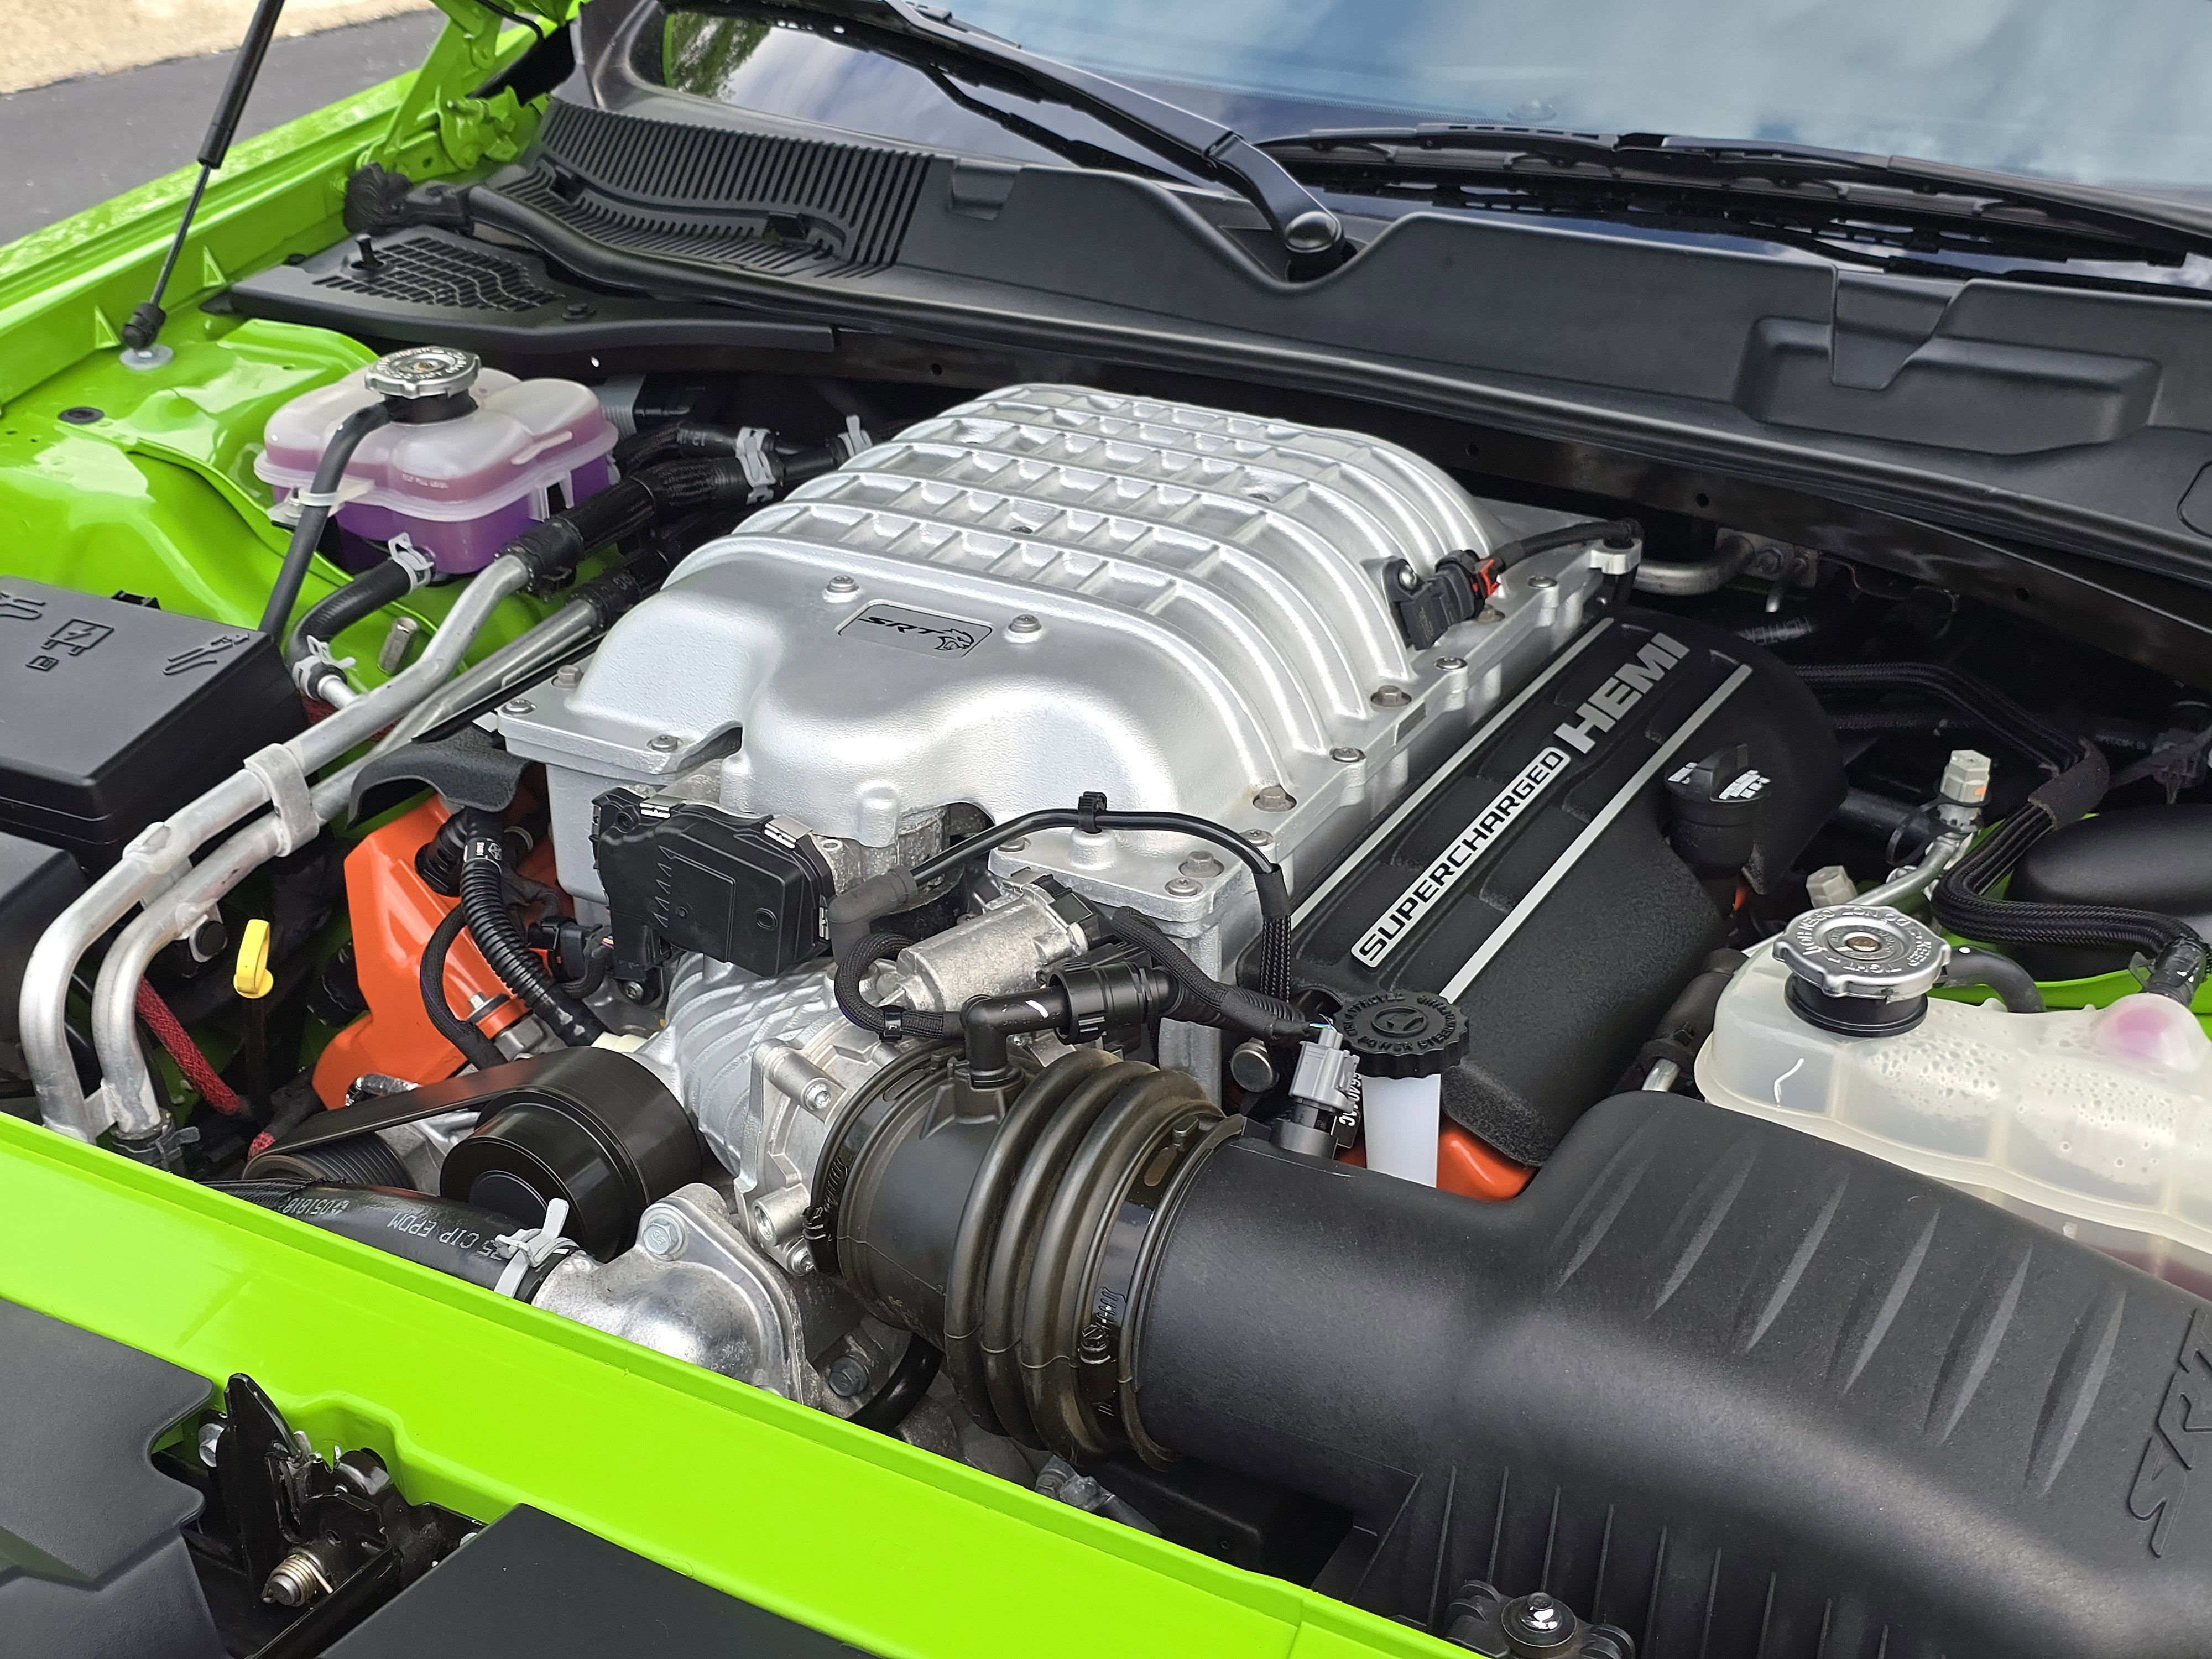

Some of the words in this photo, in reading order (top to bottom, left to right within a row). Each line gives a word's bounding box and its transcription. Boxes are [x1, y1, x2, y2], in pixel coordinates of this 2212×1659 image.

[858, 617, 946, 634] SRT
[1552, 632, 1691, 755] HEMI
[1359, 749, 1567, 963] SUPERCHARGED
[1797, 909, 1835, 930] OPEN
[1841, 907, 1878, 917] NOT
[1885, 912, 1911, 927] DO
[1906, 941, 1932, 967] KEEP
[1842, 962, 1902, 973] TIGHT
[1357, 1035, 1413, 1051] POWER
[387, 1213, 437, 1238] EPDM
[439, 1227, 479, 1249] CIP
